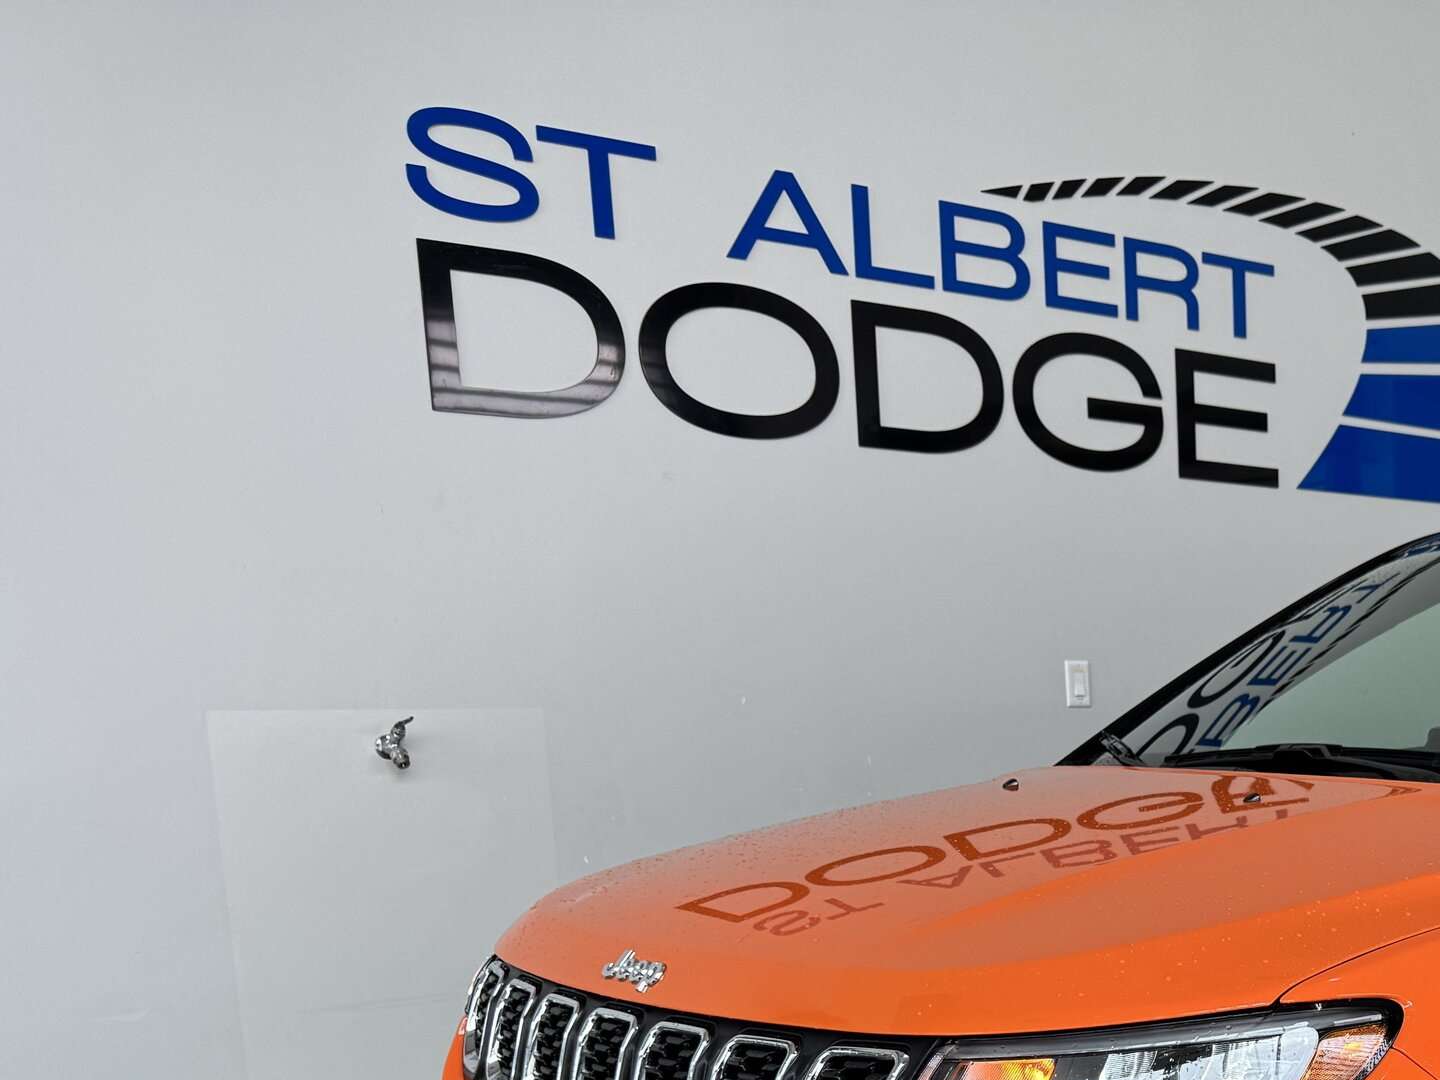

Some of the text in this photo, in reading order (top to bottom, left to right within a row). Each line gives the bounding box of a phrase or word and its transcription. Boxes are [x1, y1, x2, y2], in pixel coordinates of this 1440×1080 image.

[405, 106, 1275, 339] ST ALBERT
[415, 237, 1279, 489] DODGE
[601, 948, 667, 993] Jeep
